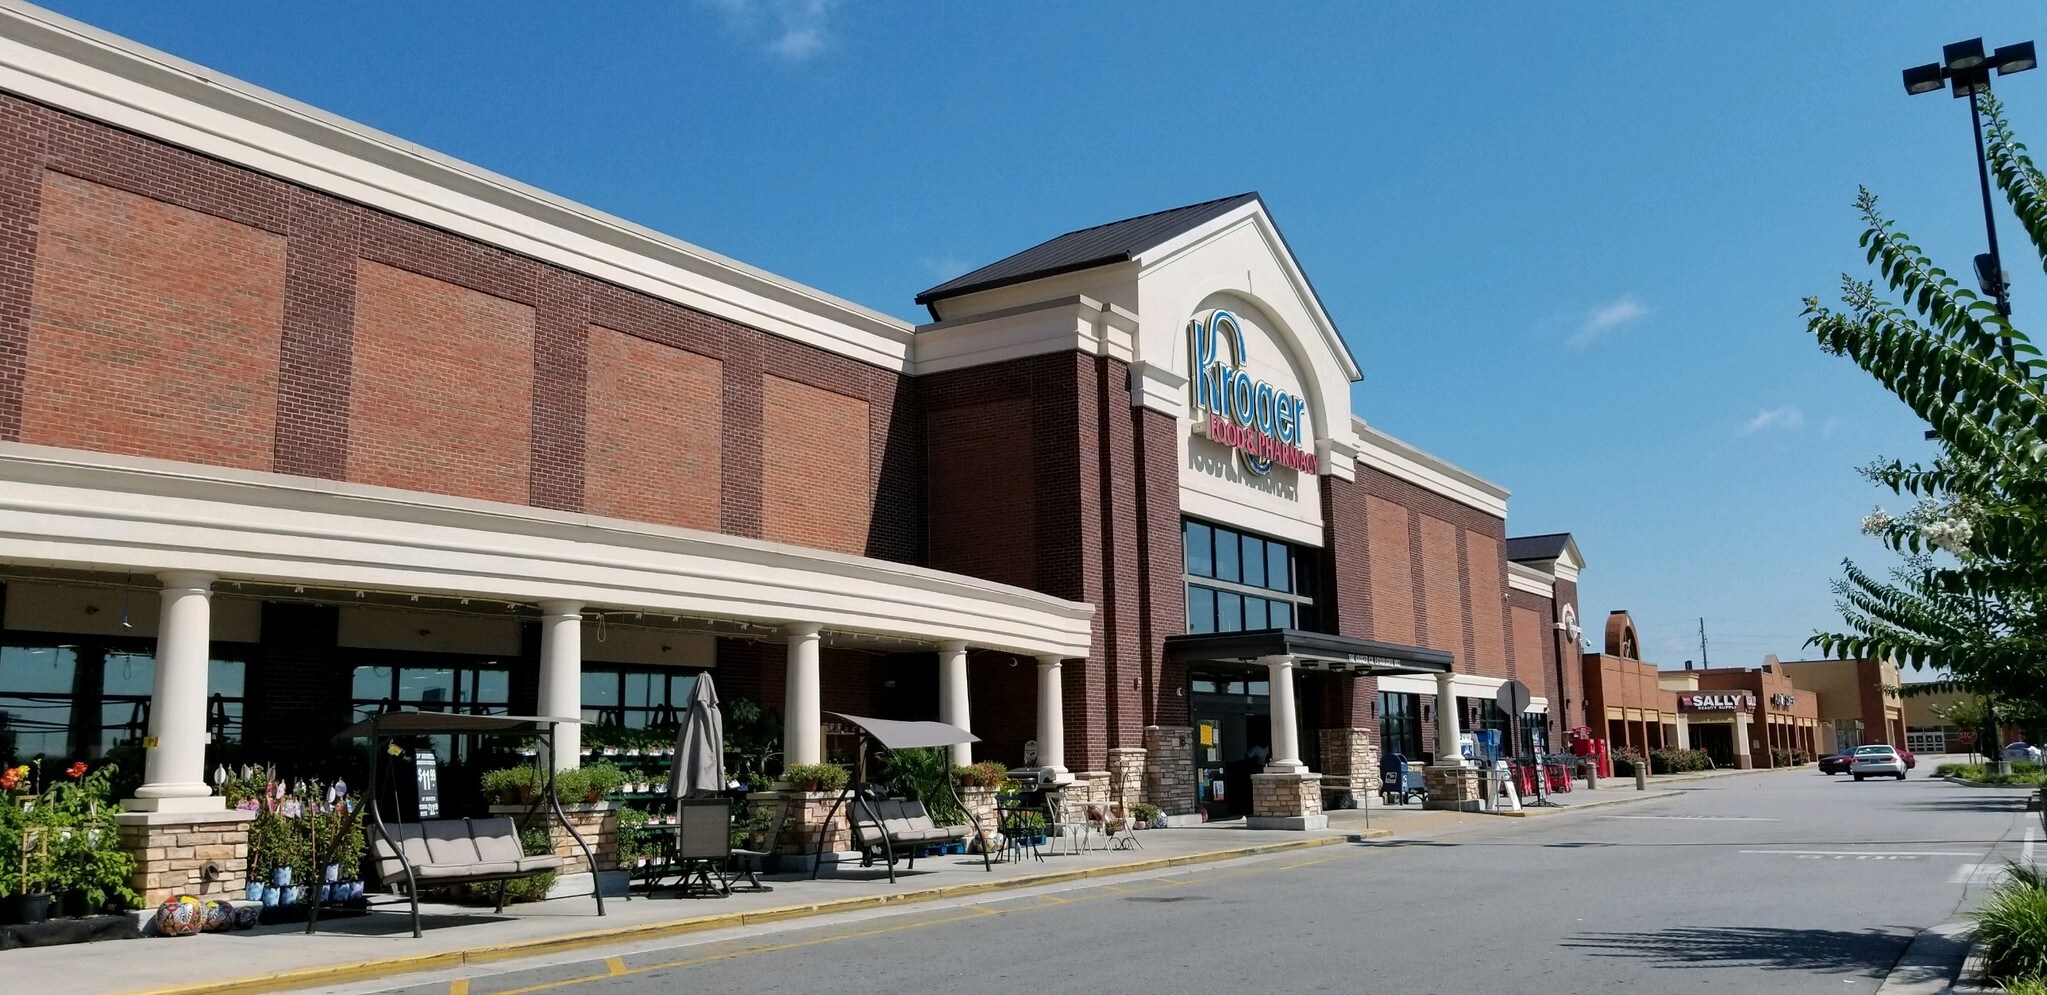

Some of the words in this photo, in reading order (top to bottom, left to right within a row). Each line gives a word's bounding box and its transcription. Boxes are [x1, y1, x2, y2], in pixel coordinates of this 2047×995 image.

[1191, 309, 1305, 475] Kroger
[1211, 413, 1245, 449] FOOD
[1257, 433, 1319, 476] PHARMACY
[1692, 695, 1742, 706] SALLY
